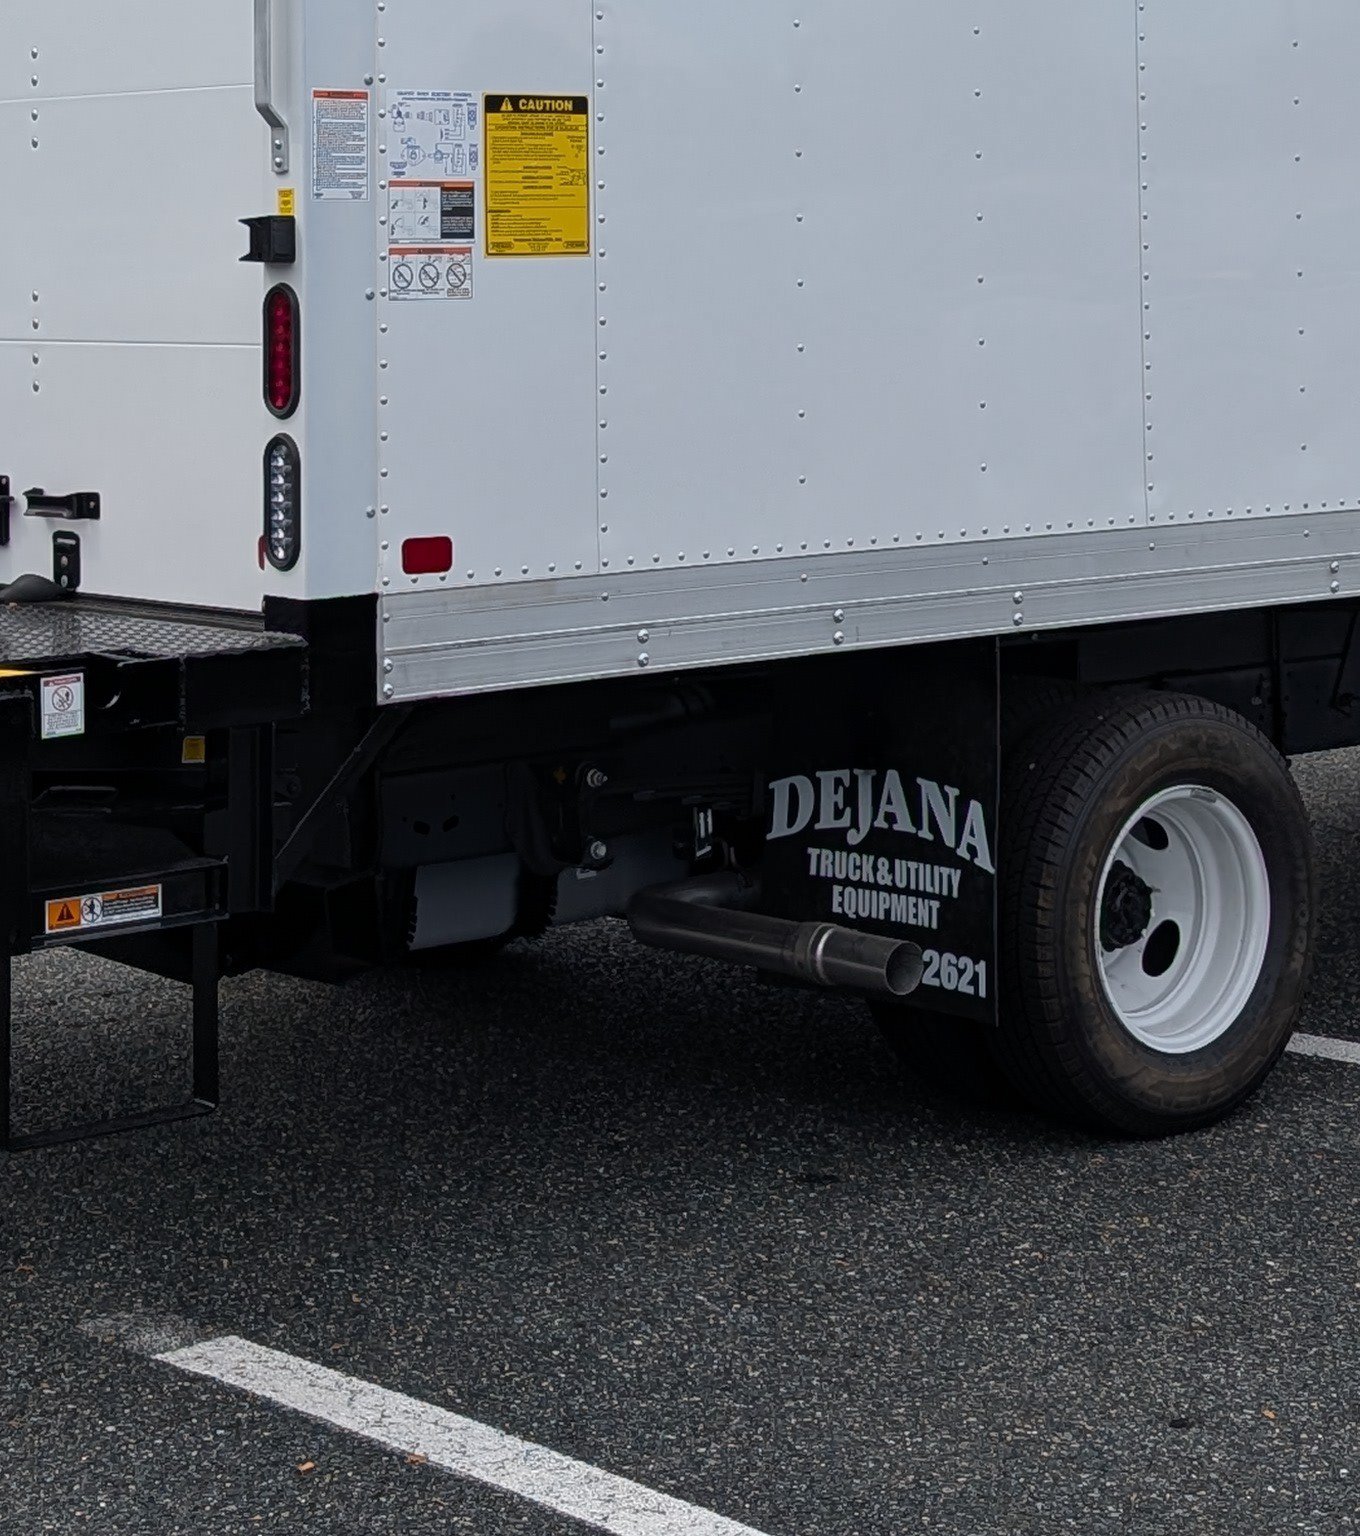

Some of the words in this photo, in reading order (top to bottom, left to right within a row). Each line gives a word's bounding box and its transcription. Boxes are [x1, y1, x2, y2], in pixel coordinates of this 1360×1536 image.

[519, 98, 573, 111] CAUTION
[766, 768, 995, 874] DEJANA
[832, 885, 940, 929] EQUIPMENT
[922, 949, 986, 998] 2621
